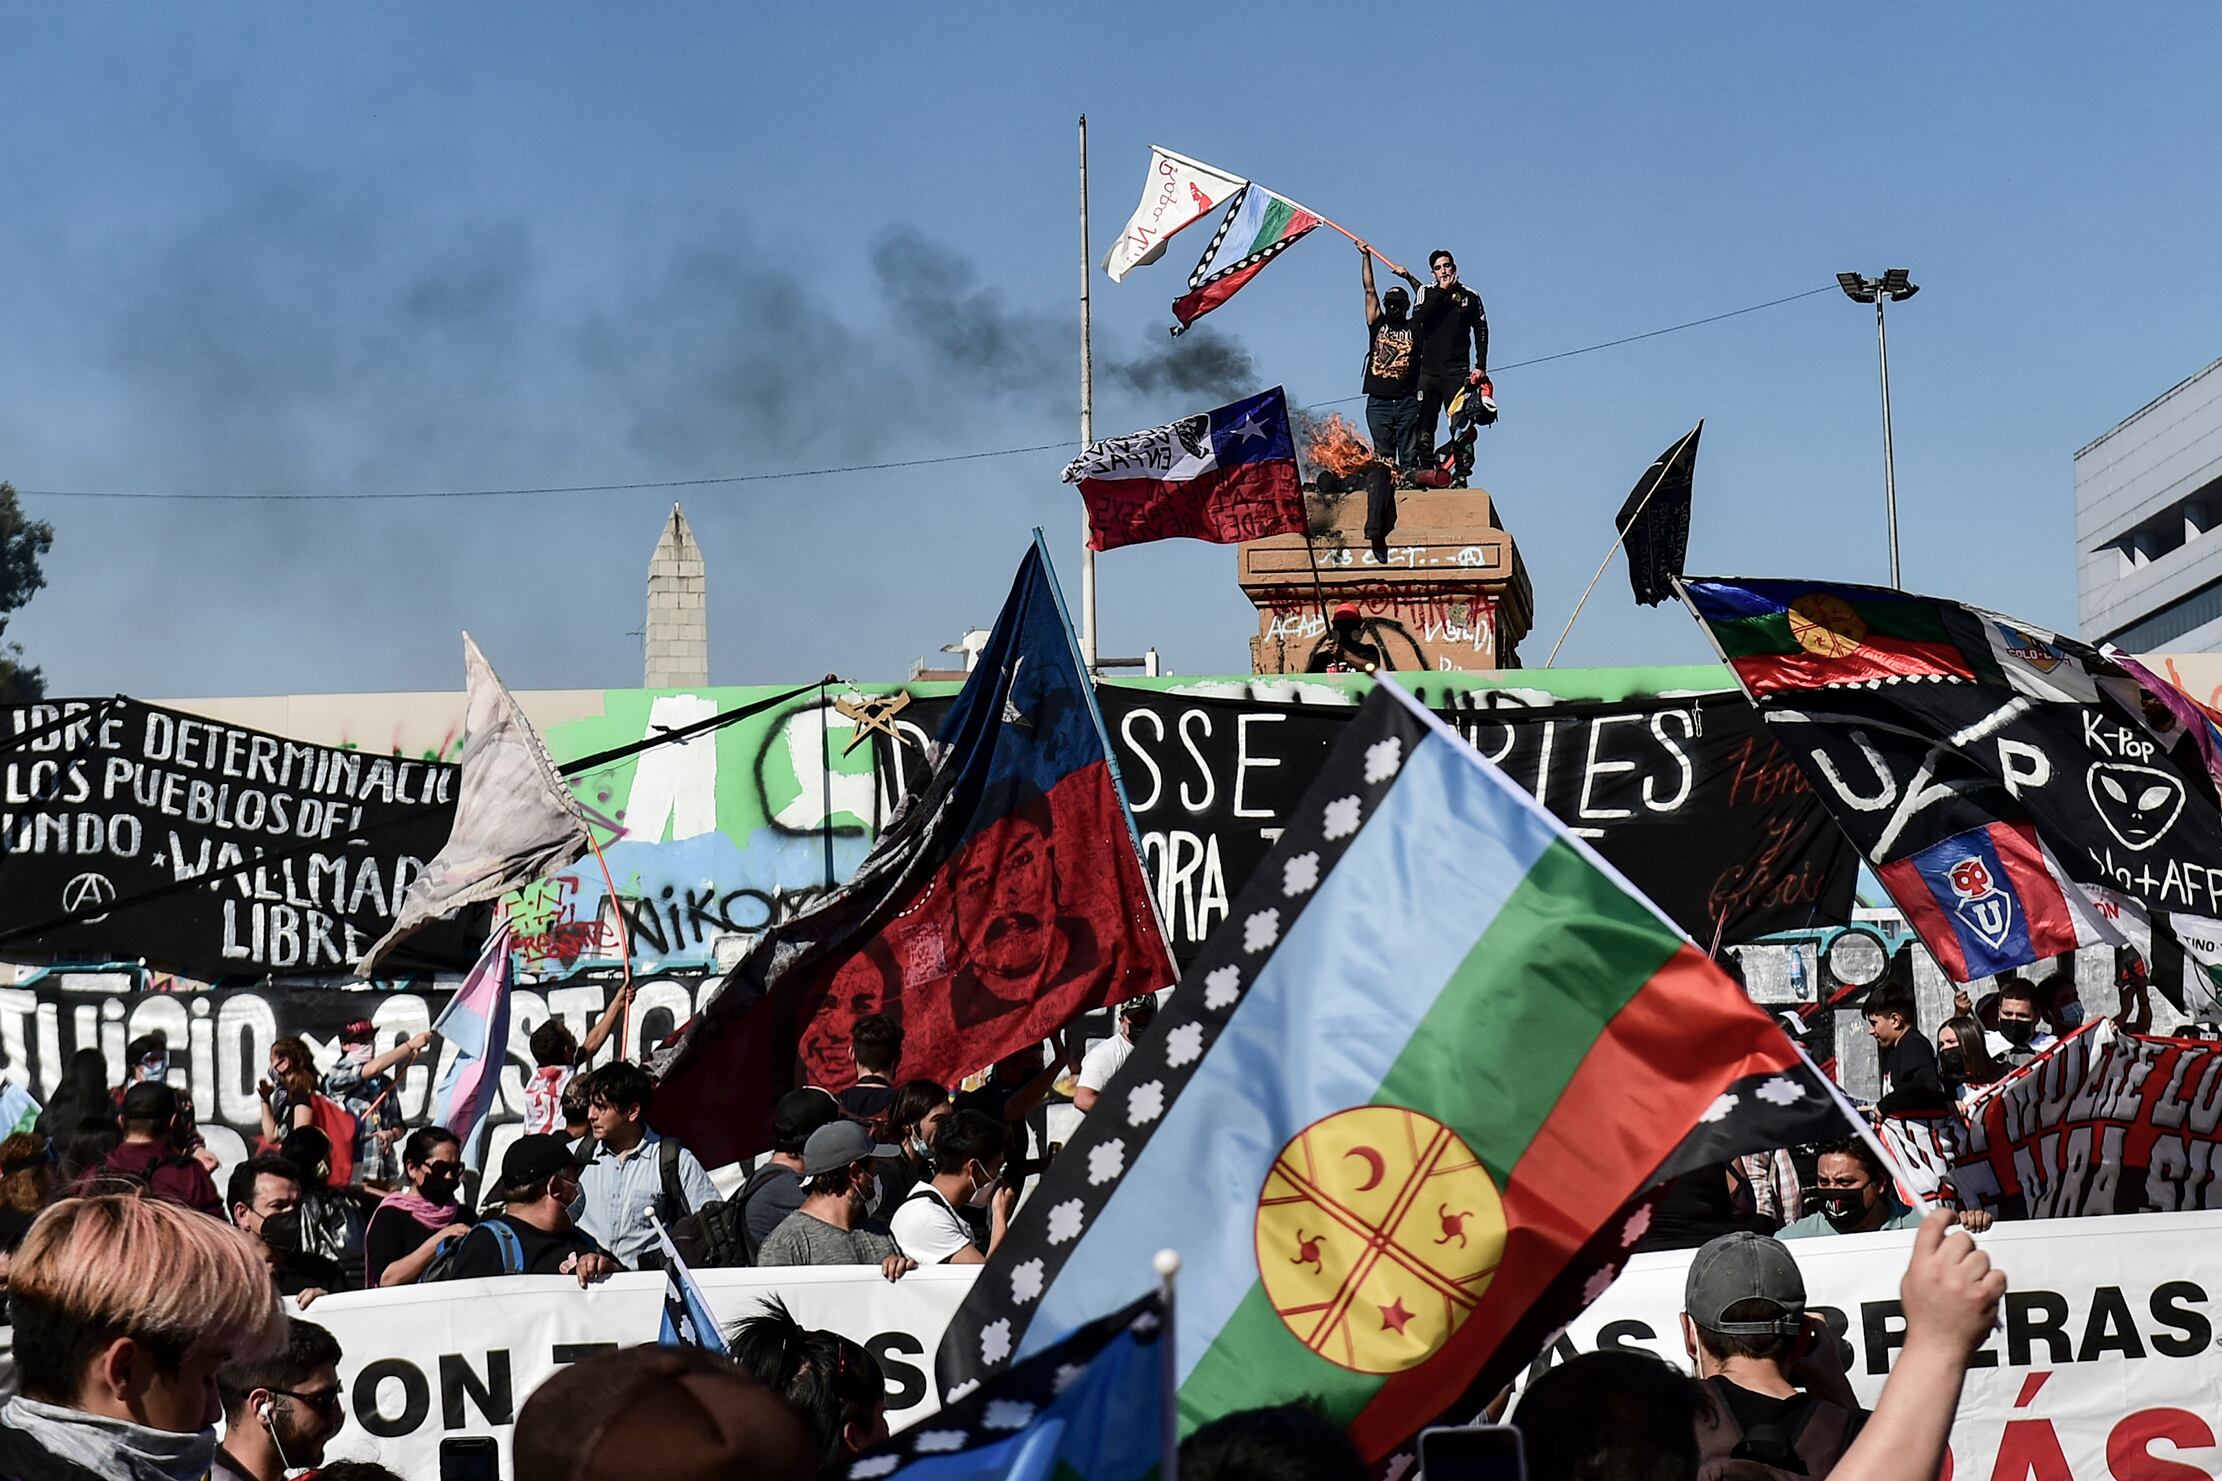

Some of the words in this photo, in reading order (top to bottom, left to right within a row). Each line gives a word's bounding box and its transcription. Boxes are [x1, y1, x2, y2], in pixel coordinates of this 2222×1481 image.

[13, 700, 127, 752] IBRE
[6, 758, 92, 804] LOS
[103, 756, 293, 835] PUEBLOS
[1121, 708, 1287, 817] SSE
[2, 811, 142, 858] UNDO
[222, 898, 370, 967] LIBRE
[1971, 899, 2004, 935] U
[340, 1348, 514, 1438] ON
[1527, 1319, 1661, 1386] AS
